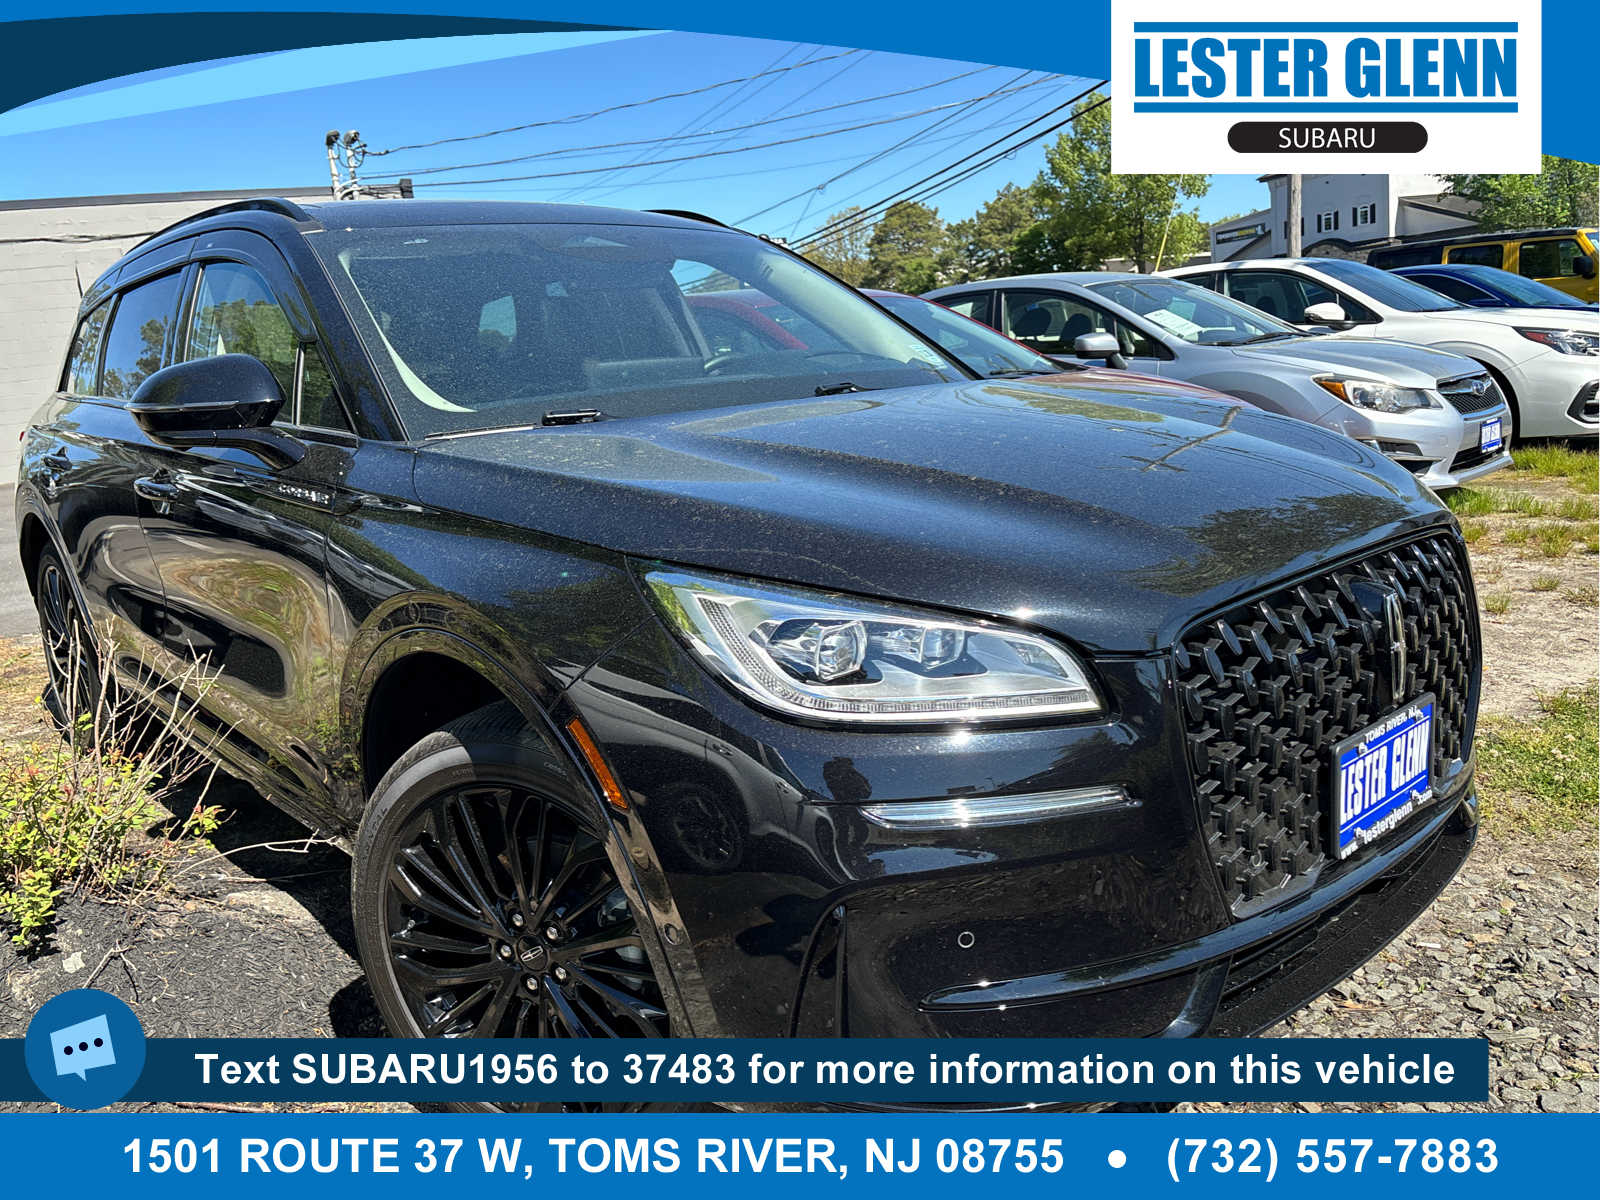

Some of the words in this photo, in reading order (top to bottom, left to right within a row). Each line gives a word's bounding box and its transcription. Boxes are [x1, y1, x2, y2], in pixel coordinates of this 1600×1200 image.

[1365, 724, 1386, 744] TOMS
[1408, 705, 1418, 719] NJ
[1340, 747, 1388, 826] LESTER
[1391, 720, 1430, 792] GLENN
